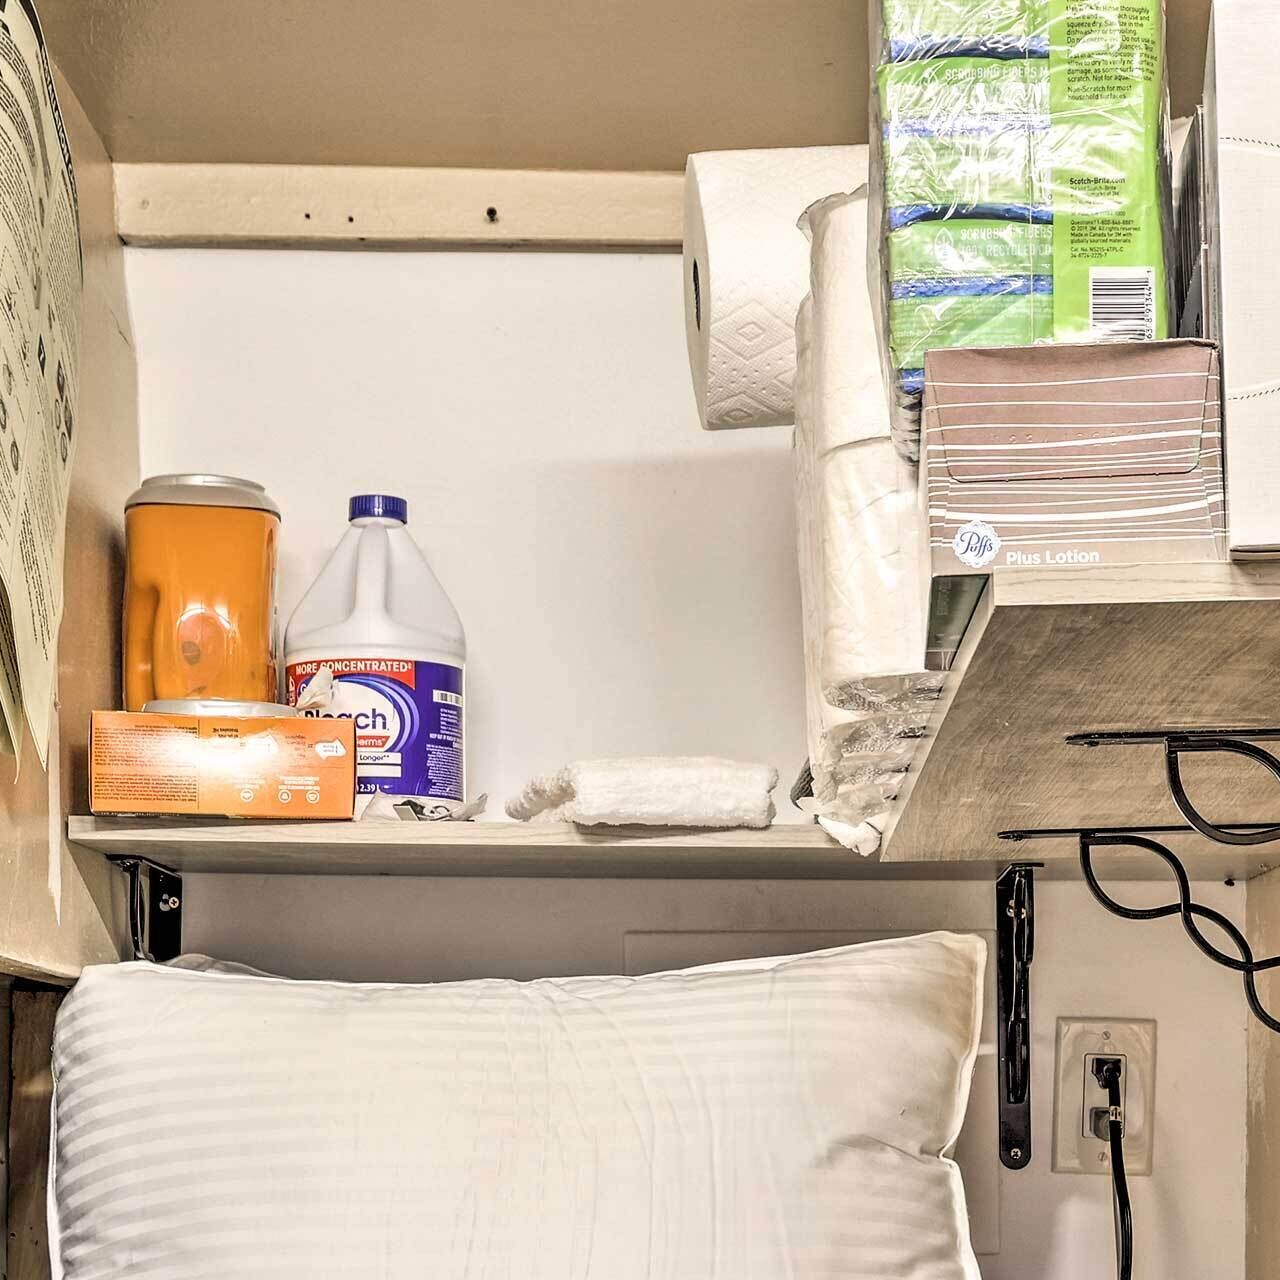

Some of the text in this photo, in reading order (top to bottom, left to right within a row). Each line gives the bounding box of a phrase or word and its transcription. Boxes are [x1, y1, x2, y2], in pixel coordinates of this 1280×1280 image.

[1120, 5, 1149, 14] thoroughly
[959, 531, 993, 558] Puffs
[1006, 549, 1100, 565] Plus Lotion
[295, 663, 318, 675] MORE
[359, 783, 376, 792] 2.39
